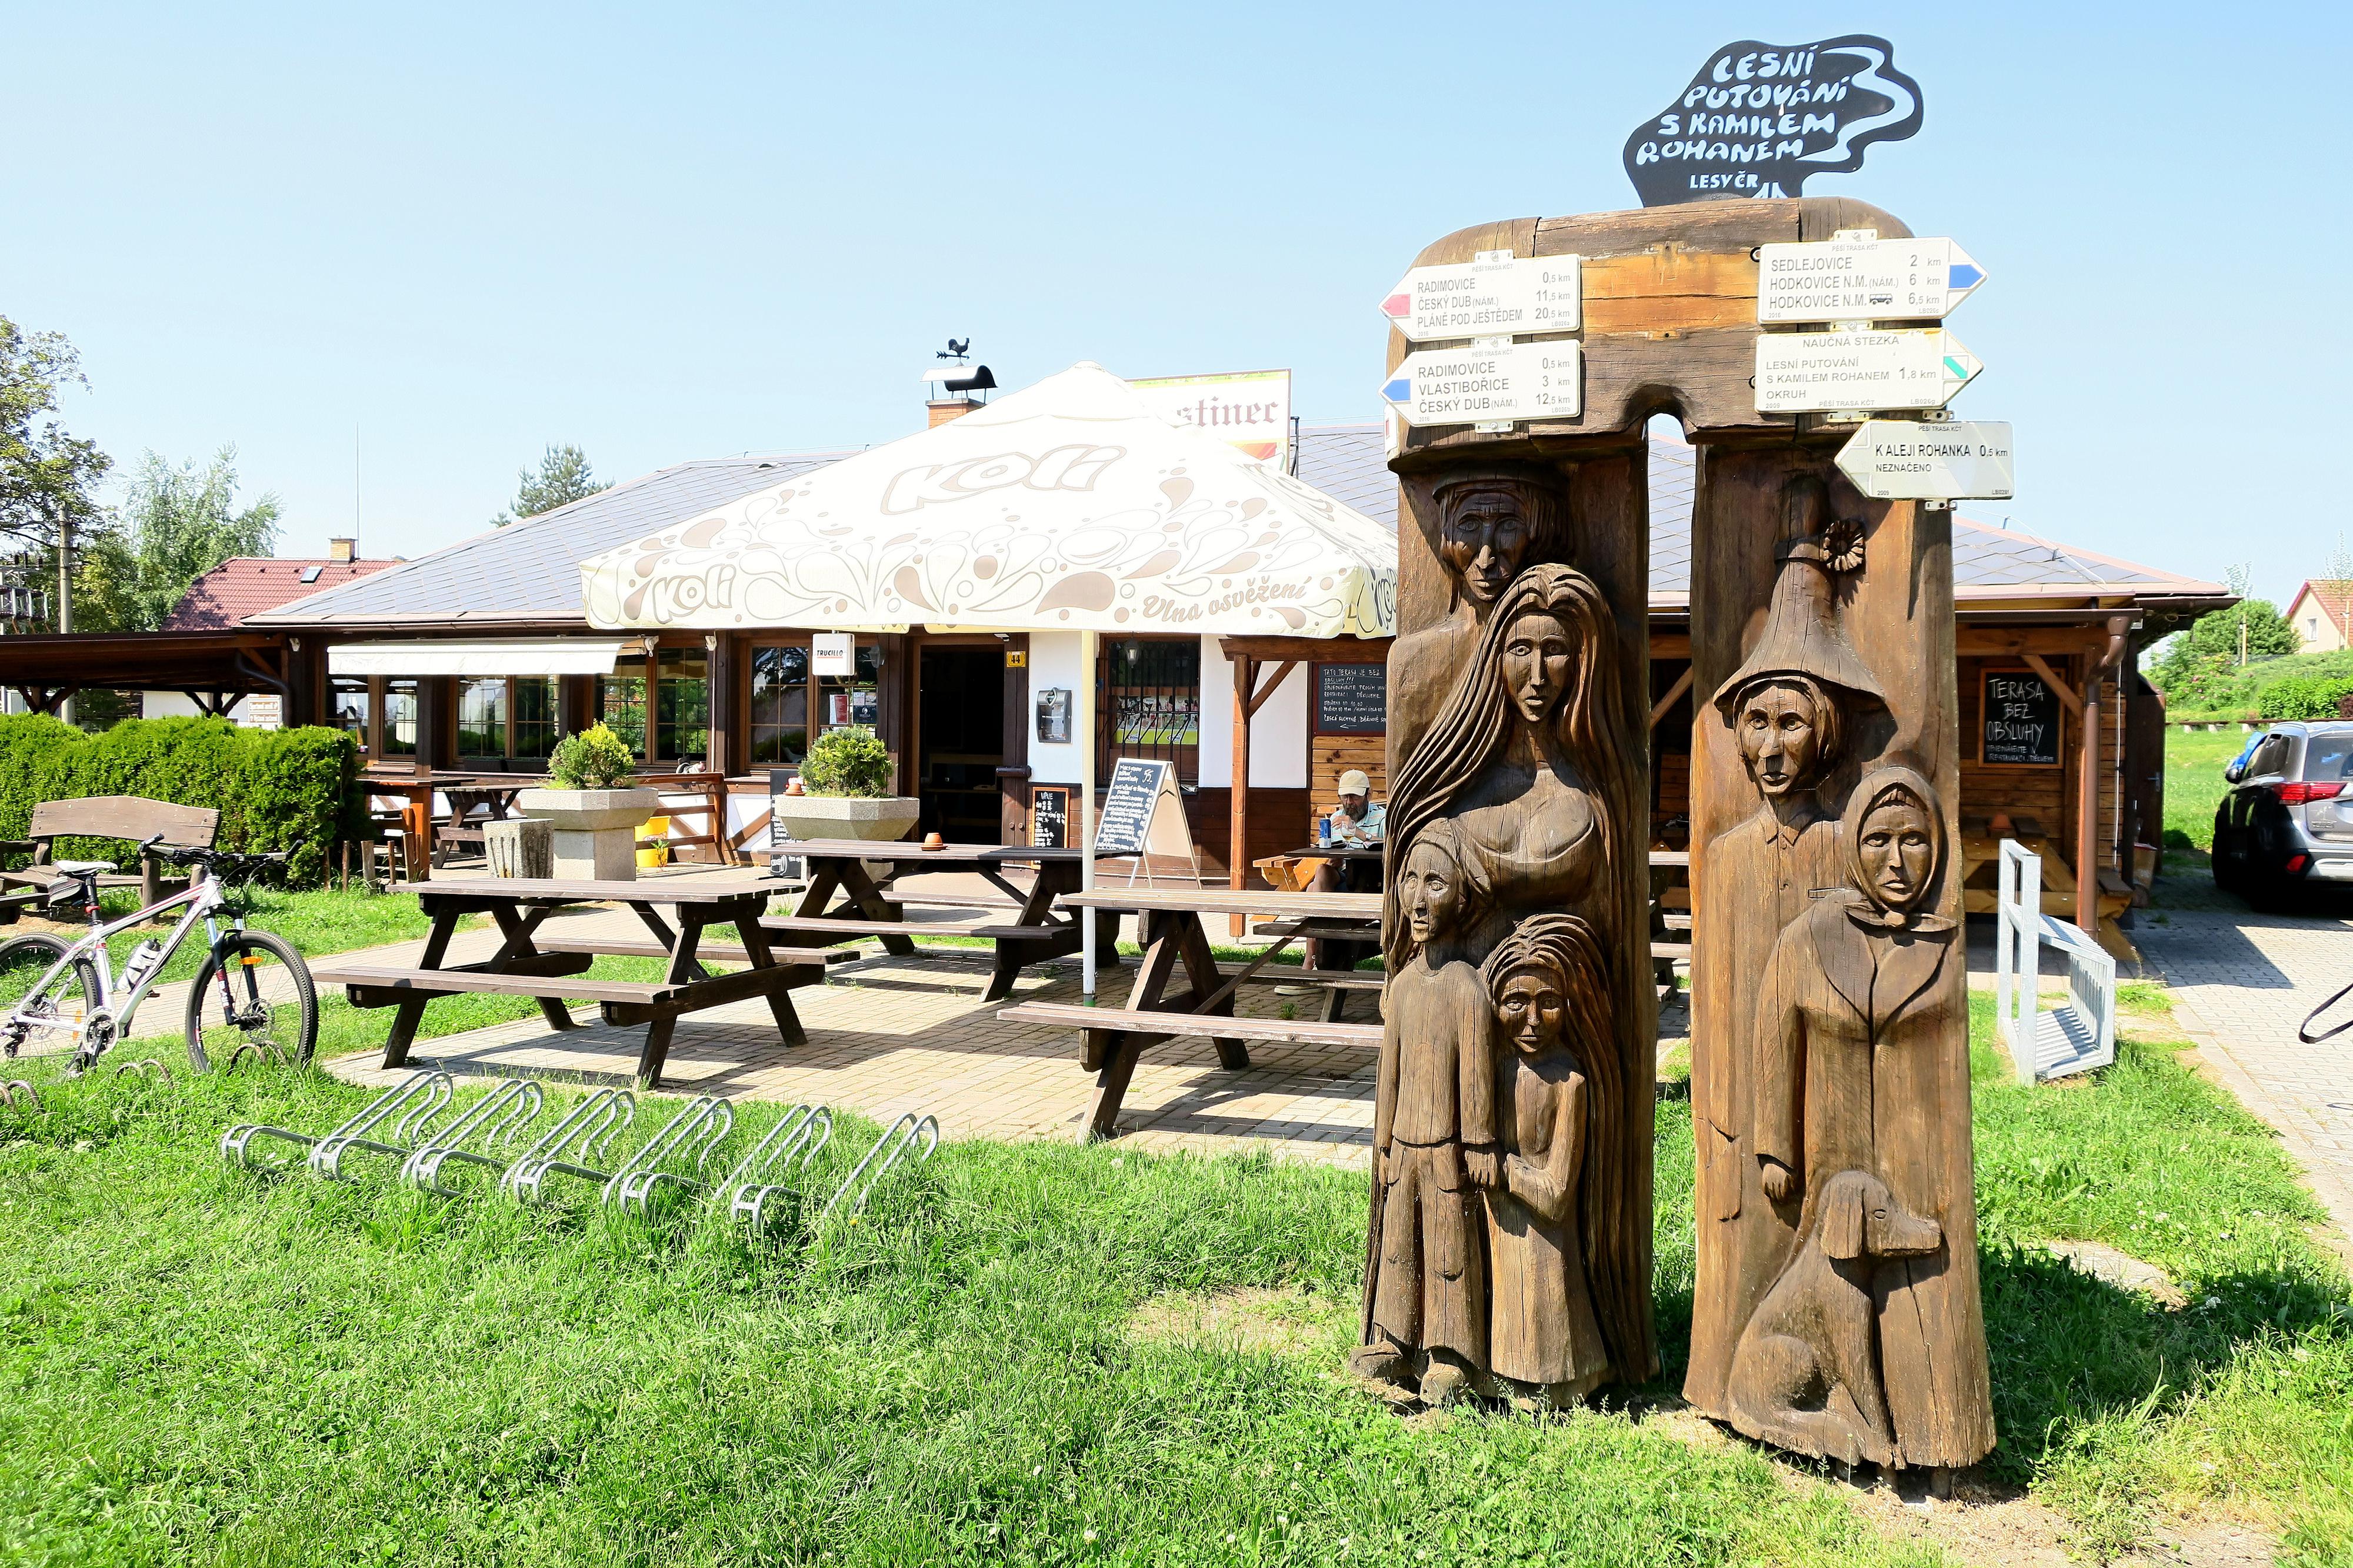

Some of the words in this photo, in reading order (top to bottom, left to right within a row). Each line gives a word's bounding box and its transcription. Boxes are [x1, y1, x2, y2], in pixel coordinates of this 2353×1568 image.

[1684, 75, 1850, 109] PUTOVÁNÍ
[1658, 114, 1680, 135] S
[1689, 112, 1836, 138] KAMILEM
[1636, 138, 1804, 165] ROHANEM
[1689, 174, 1733, 188] LESY
[1734, 170, 1758, 188] ČR
[1771, 257, 1852, 272] SEDLEJOVICE
[1909, 255, 1918, 266] 2
[1927, 258, 1941, 266] km
[1418, 278, 1475, 293] RADIMOVICE
[1542, 272, 1556, 284] 0,5
[1770, 276, 1839, 290] HODKOVICE
[1844, 275, 1868, 288] N.M.
[1909, 273, 1917, 285] 6
[1927, 276, 1940, 285] km
[1418, 294, 1449, 311] ČESKÝ
[1452, 296, 1471, 308] DUB
[1536, 289, 1556, 302] 11,5
[1769, 295, 1839, 309] HODKOVICE
[1842, 294, 1867, 306] N.M.
[1908, 292, 1924, 306] 6,5
[1926, 295, 1939, 304] km
[1418, 312, 1448, 328] PLÁNĚ
[1451, 313, 1470, 325] POD
[1473, 307, 1522, 324] JEŠTĚDEM
[1535, 307, 1556, 319] 20,5
[1558, 309, 1570, 318] km
[1803, 336, 1851, 348] NAUČNÁ
[1855, 336, 1899, 346] STEZKA
[1418, 361, 1495, 378] RADIMOVICE
[1542, 358, 1555, 370] 0,5
[1766, 358, 1798, 370] LESNÍ
[1802, 356, 1859, 369] PUTOVÁNÍ
[1767, 375, 1773, 383] S
[1777, 373, 1828, 383] KAMILEM
[1832, 371, 1889, 381] ROHANEM
[1899, 367, 1917, 380] 1,8
[1920, 370, 1937, 378] km
[1418, 376, 1509, 396] VLASTIBOŘICE
[1542, 375, 1549, 387] 3
[1767, 389, 1807, 399] OKRUH
[1419, 396, 1460, 413] ČESKÝ
[1465, 398, 1490, 410] DUB
[1536, 393, 1555, 406] 12,5
[1876, 444, 1882, 456] K
[1885, 444, 1915, 456] ALEJI
[1918, 444, 1971, 456] ROHANKA
[1996, 448, 2008, 456] km
[1876, 462, 1932, 472] NEZNAČENO
[1143, 595, 1203, 622] Vlna
[1208, 575, 1312, 615] osvěžení
[1011, 655, 1020, 663] 44
[1988, 678, 2045, 701] TERASA
[2002, 703, 2035, 720] BEZ
[1986, 721, 2044, 745] OBSLUHY
